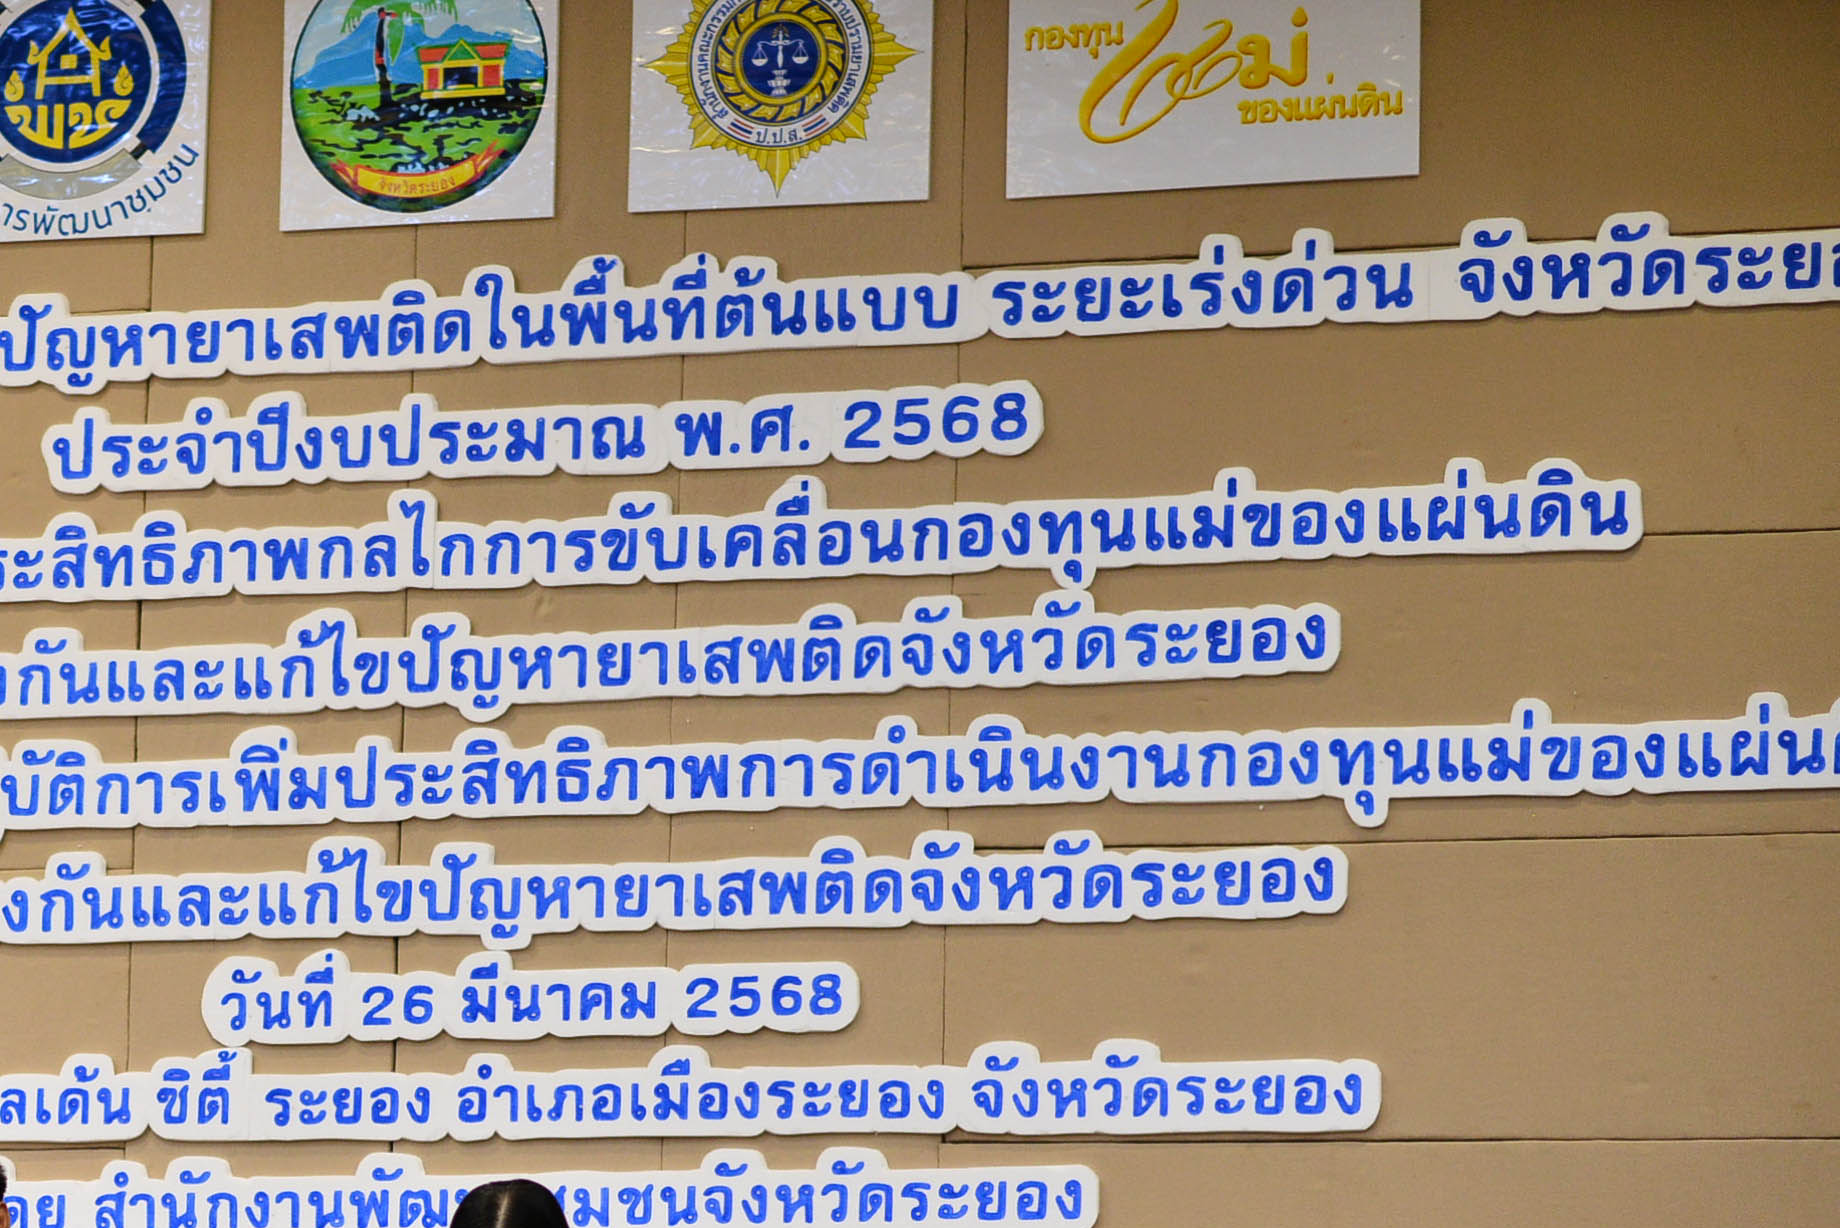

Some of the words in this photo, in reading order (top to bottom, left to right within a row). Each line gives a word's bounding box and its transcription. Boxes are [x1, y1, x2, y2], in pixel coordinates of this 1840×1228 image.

[1024, 18, 1124, 59] กองทุน
[755, 127, 802, 145] ป.ป.ส.
[1237, 73, 1404, 125] ของแผ่นดิน
[991, 239, 1415, 327] ระยะเร่งด่วน
[1459, 223, 1840, 304] จังหวัดระย
[52, 401, 647, 481] ประจำปีงบประมาณ
[674, 404, 811, 457] พ.ศ.
[844, 391, 1029, 449] 2568
[220, 952, 335, 1032] วันที่
[361, 984, 435, 1027] 26
[461, 961, 657, 1024] มีนาคม
[685, 972, 843, 1019] 2568
[264, 1085, 431, 1128] ระยอง
[457, 1058, 945, 1124] อำเภอเมืองระยอง
[971, 1053, 1363, 1119] จังหวัดระยอง
